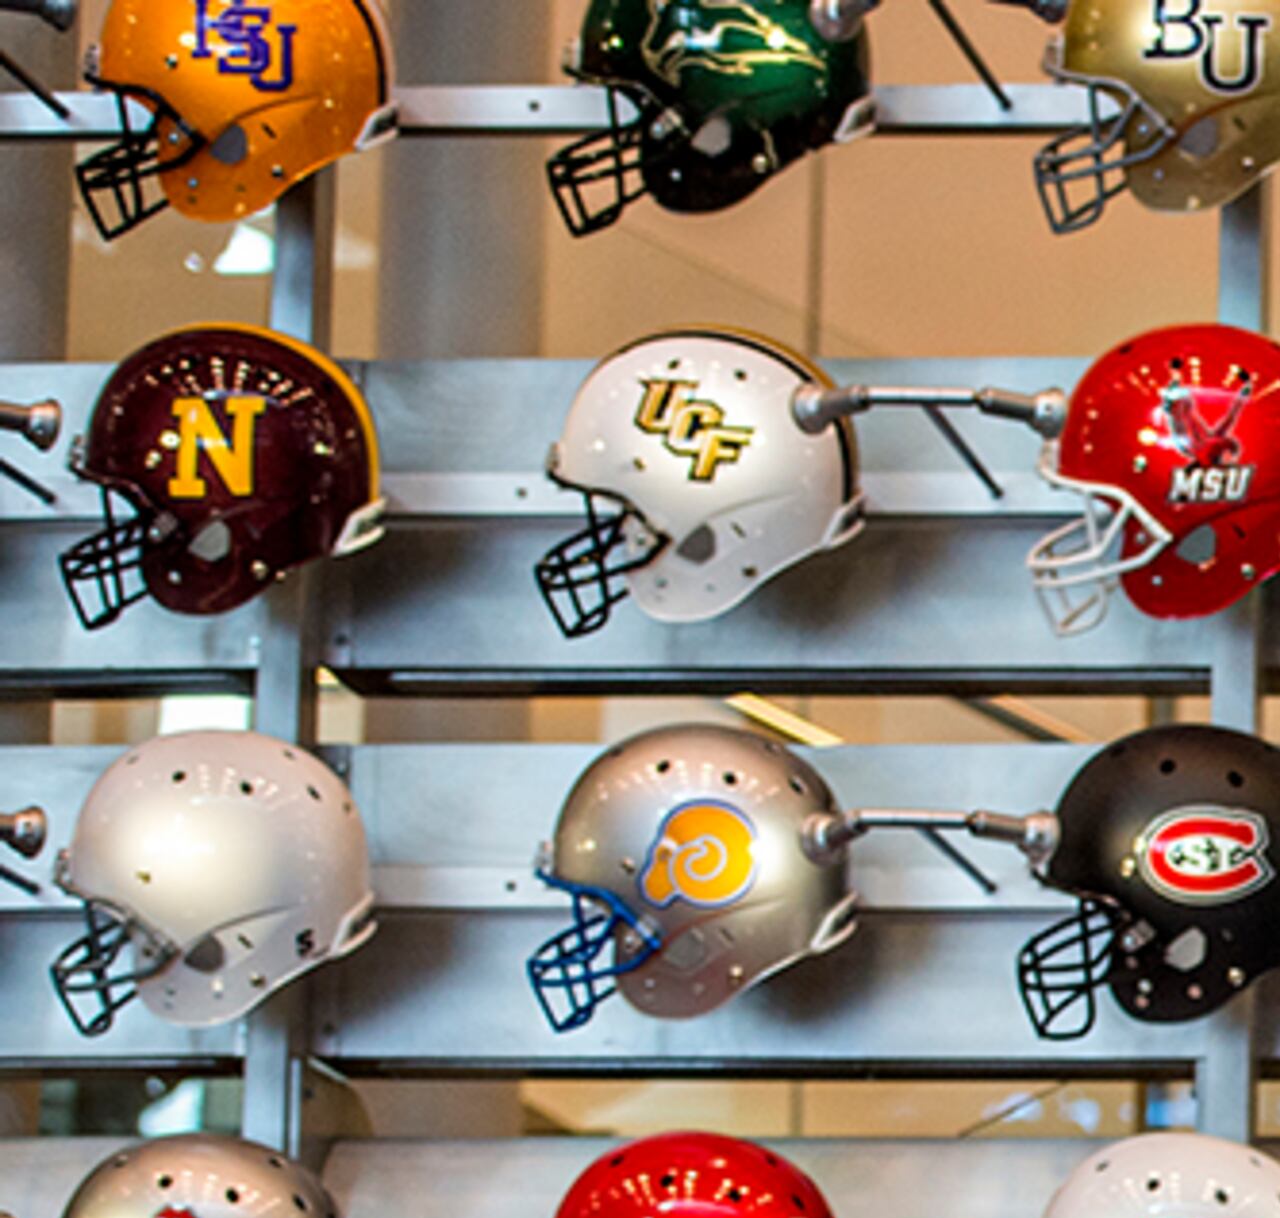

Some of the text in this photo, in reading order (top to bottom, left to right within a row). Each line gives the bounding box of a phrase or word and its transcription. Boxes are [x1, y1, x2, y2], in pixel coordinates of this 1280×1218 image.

[1143, 0, 1268, 91] BU
[168, 395, 265, 498] N
[636, 375, 754, 483] UCF
[1167, 464, 1255, 503] MSU
